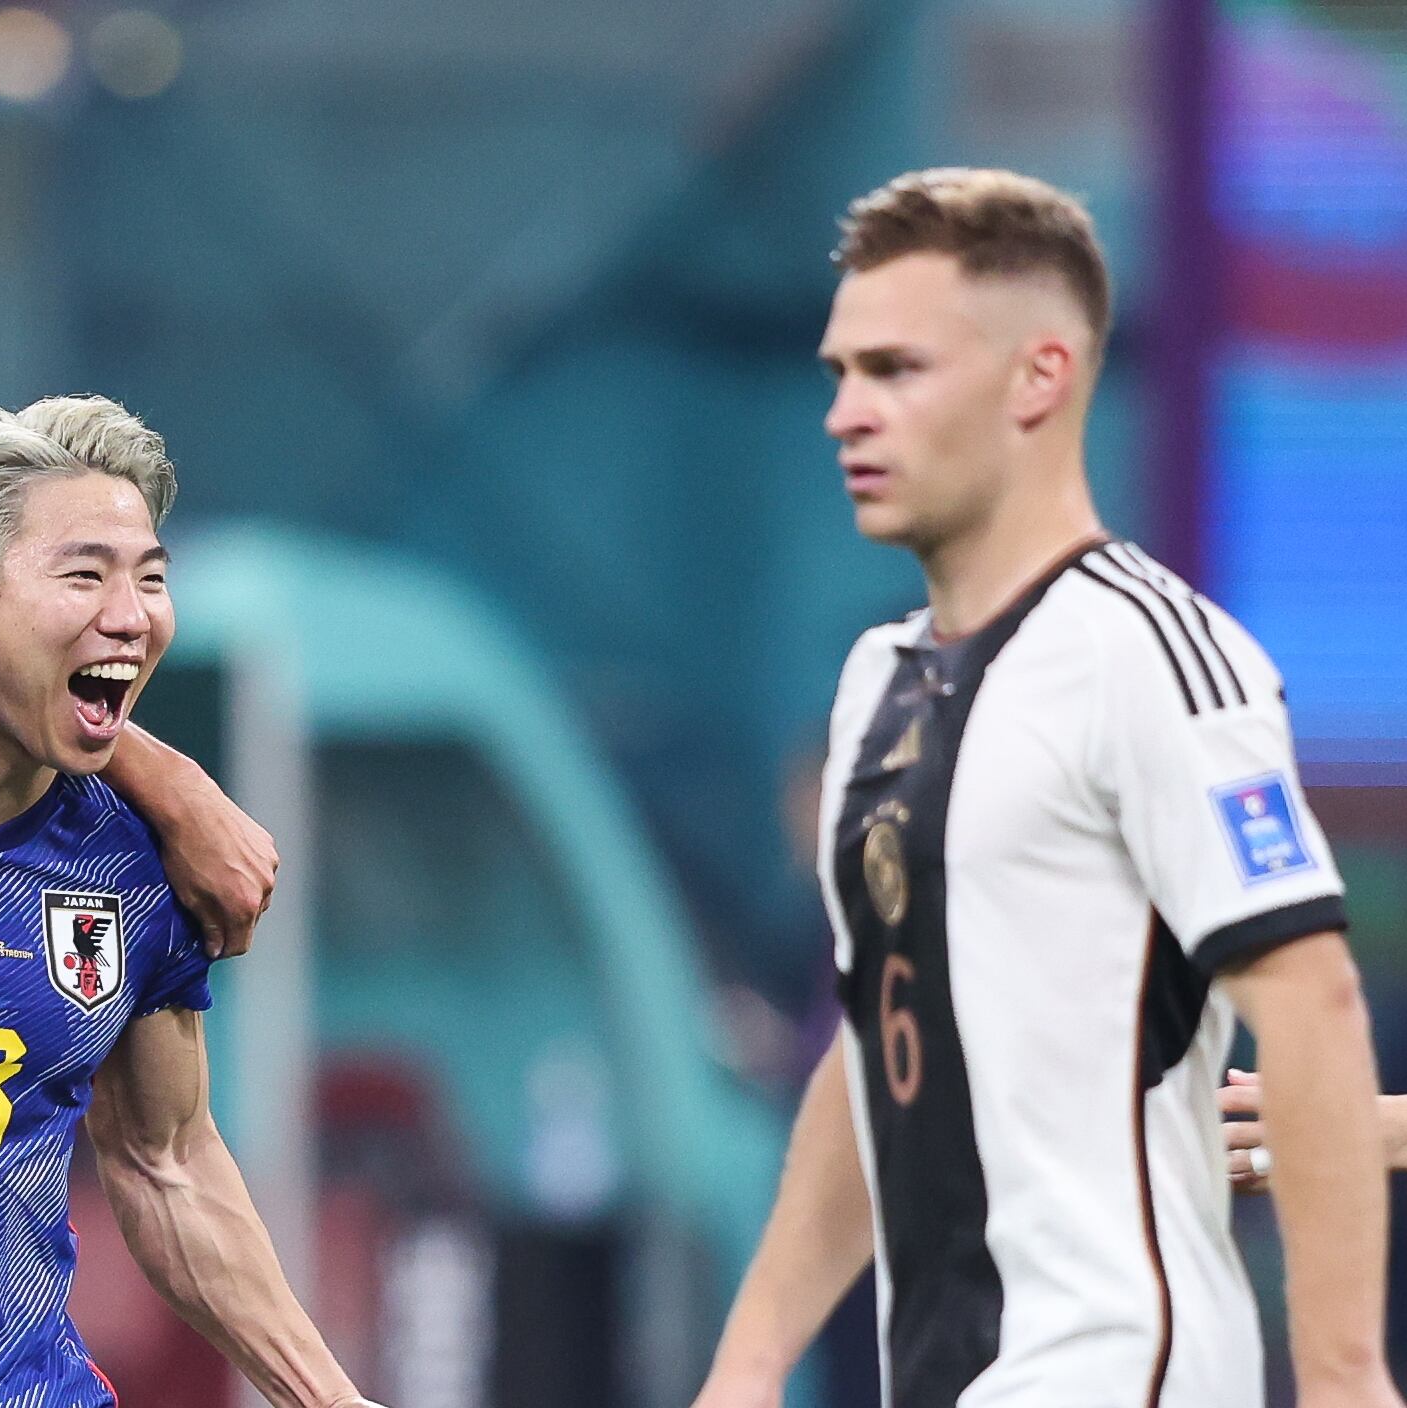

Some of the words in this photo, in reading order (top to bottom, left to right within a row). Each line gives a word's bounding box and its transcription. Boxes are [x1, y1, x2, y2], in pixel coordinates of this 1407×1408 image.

[63, 896, 104, 909] JAPAN
[0, 948, 33, 960] STADIUM
[880, 953, 923, 1109] 6
